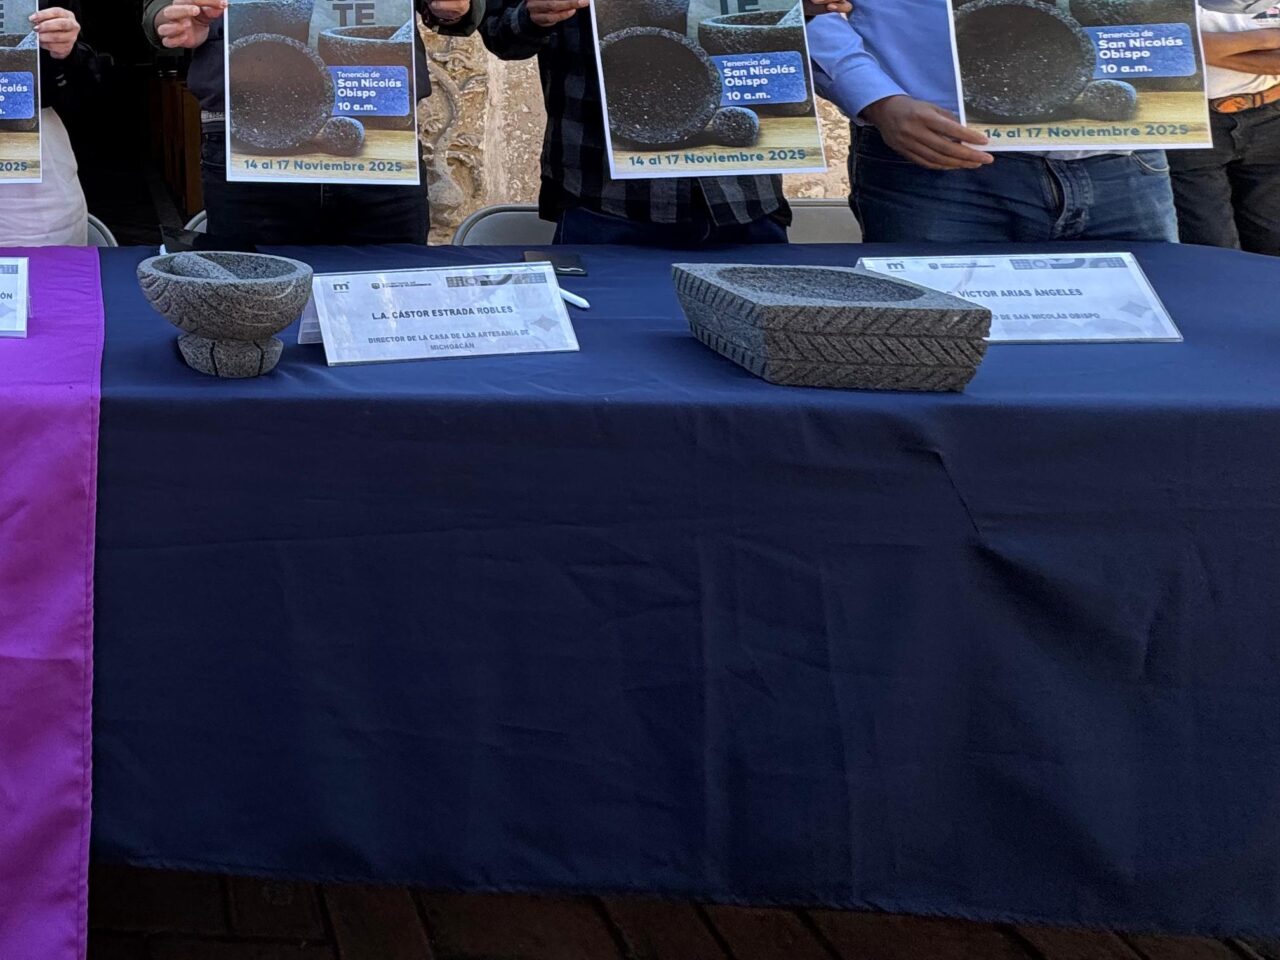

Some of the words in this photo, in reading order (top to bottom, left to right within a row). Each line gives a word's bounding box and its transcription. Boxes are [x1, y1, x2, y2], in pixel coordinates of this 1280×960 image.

[332, 4, 375, 26] TE
[1098, 40, 1127, 49] San
[1130, 37, 1183, 48] Nicolás
[1099, 49, 1150, 60] Obispo
[724, 67, 748, 76] San
[750, 65, 796, 75] Nicolás
[1100, 64, 1117, 74] 10
[1120, 64, 1152, 72] a.m.
[338, 79, 358, 87] San
[361, 79, 401, 88] Nicolás
[724, 76, 768, 87] Obispo
[338, 89, 376, 98] Obispo
[726, 92, 740, 100] 10
[744, 91, 771, 100] a.m.
[338, 102, 350, 110] 10
[984, 128, 1002, 139] 14
[1006, 127, 1020, 138] al
[1027, 126, 1041, 138] 17
[1048, 125, 1140, 138] Noviembre
[1146, 123, 1188, 135] 2025
[630, 156, 644, 166] 14
[649, 155, 660, 165] al
[665, 154, 679, 164] 17
[684, 151, 764, 164] Noviembre
[768, 149, 806, 160] 2025
[244, 160, 257, 169] 14
[262, 160, 273, 169] al
[277, 160, 289, 169] 17
[294, 161, 365, 171] Noviembre
[369, 162, 402, 172] 2025
[392, 309, 429, 318] CÁSTOR
[432, 309, 475, 317] ESTRADA
[477, 306, 513, 315] ROBLES
